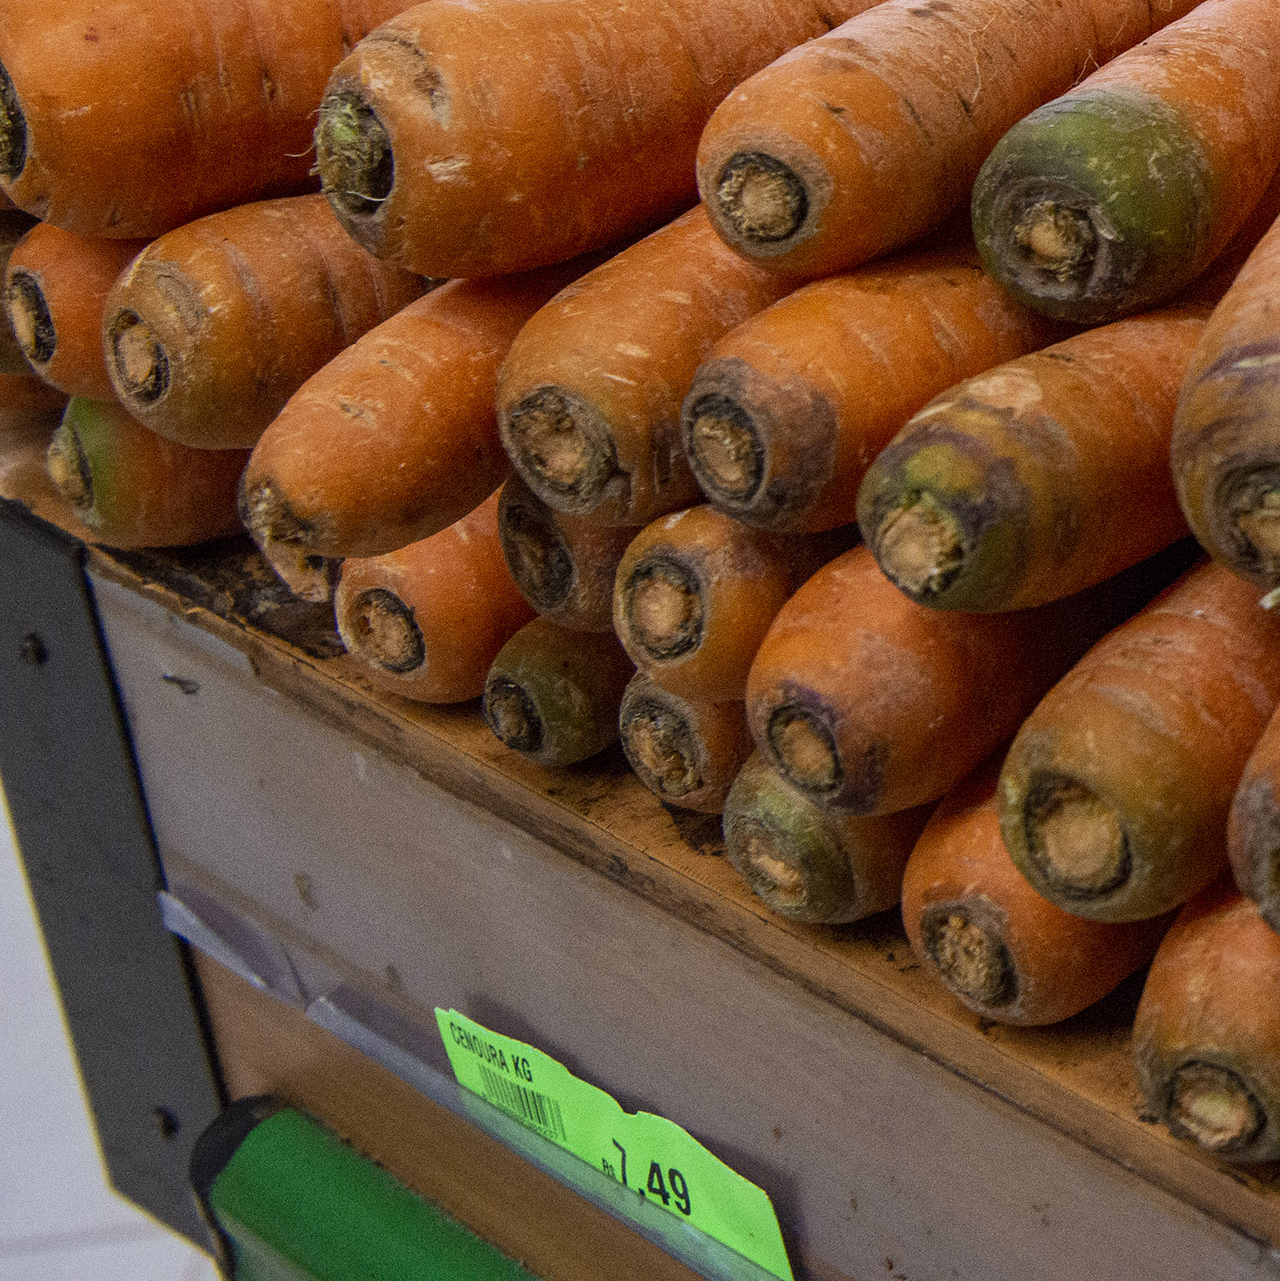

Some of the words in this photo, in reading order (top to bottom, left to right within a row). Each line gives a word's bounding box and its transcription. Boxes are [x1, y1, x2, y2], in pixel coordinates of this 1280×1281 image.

[449, 1021, 510, 1074] CENOURA
[511, 1053, 534, 1083] KG
[611, 1137, 692, 1216] 7,49
